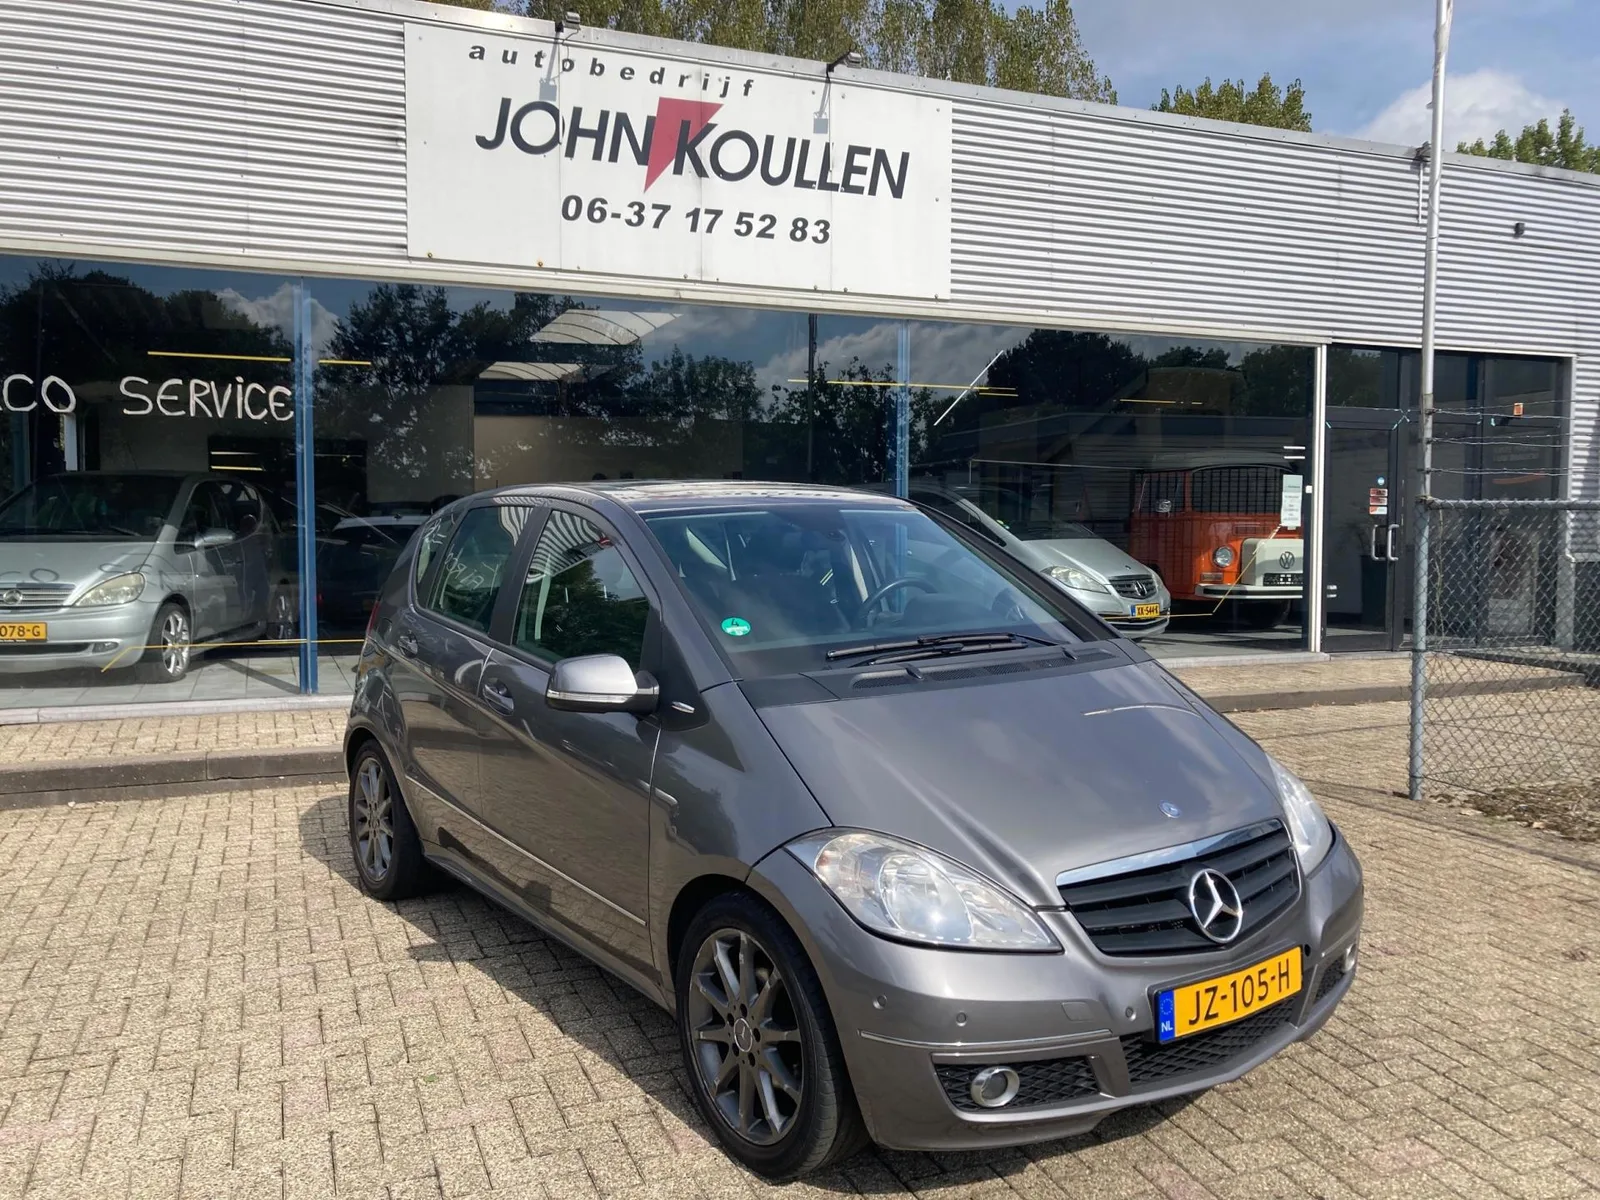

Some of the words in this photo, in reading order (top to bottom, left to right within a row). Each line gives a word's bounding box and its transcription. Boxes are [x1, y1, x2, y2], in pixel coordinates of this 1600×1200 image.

[468, 45, 755, 98] autobedrijf
[475, 97, 657, 166] JOHN
[672, 118, 910, 200] KOULLEN
[561, 194, 672, 231] 06-37
[684, 207, 724, 235] 17
[734, 213, 778, 240] 52
[789, 216, 832, 245] 83
[0, 374, 76, 413] CO
[1161, 1020, 1174, 1033] NL
[1188, 957, 1290, 1026] JZ-105-H
